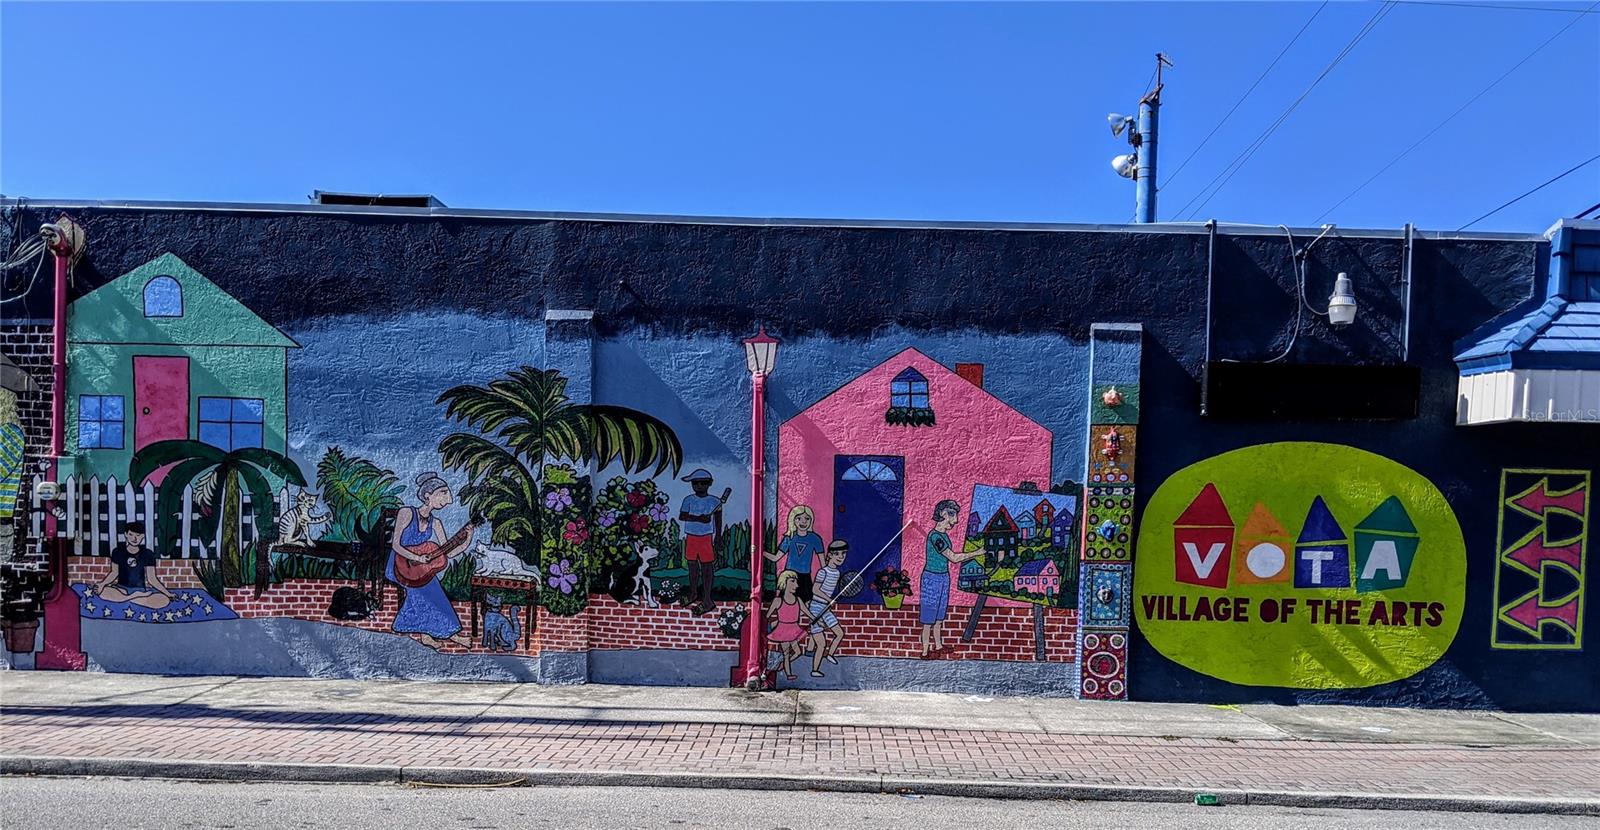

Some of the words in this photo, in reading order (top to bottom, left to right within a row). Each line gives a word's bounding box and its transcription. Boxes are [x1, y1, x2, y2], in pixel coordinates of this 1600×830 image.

[1141, 595, 1250, 623] VILLAGE
[1259, 598, 1298, 624] OF
[1305, 599, 1361, 625] THE
[1367, 599, 1446, 627] ARTS
